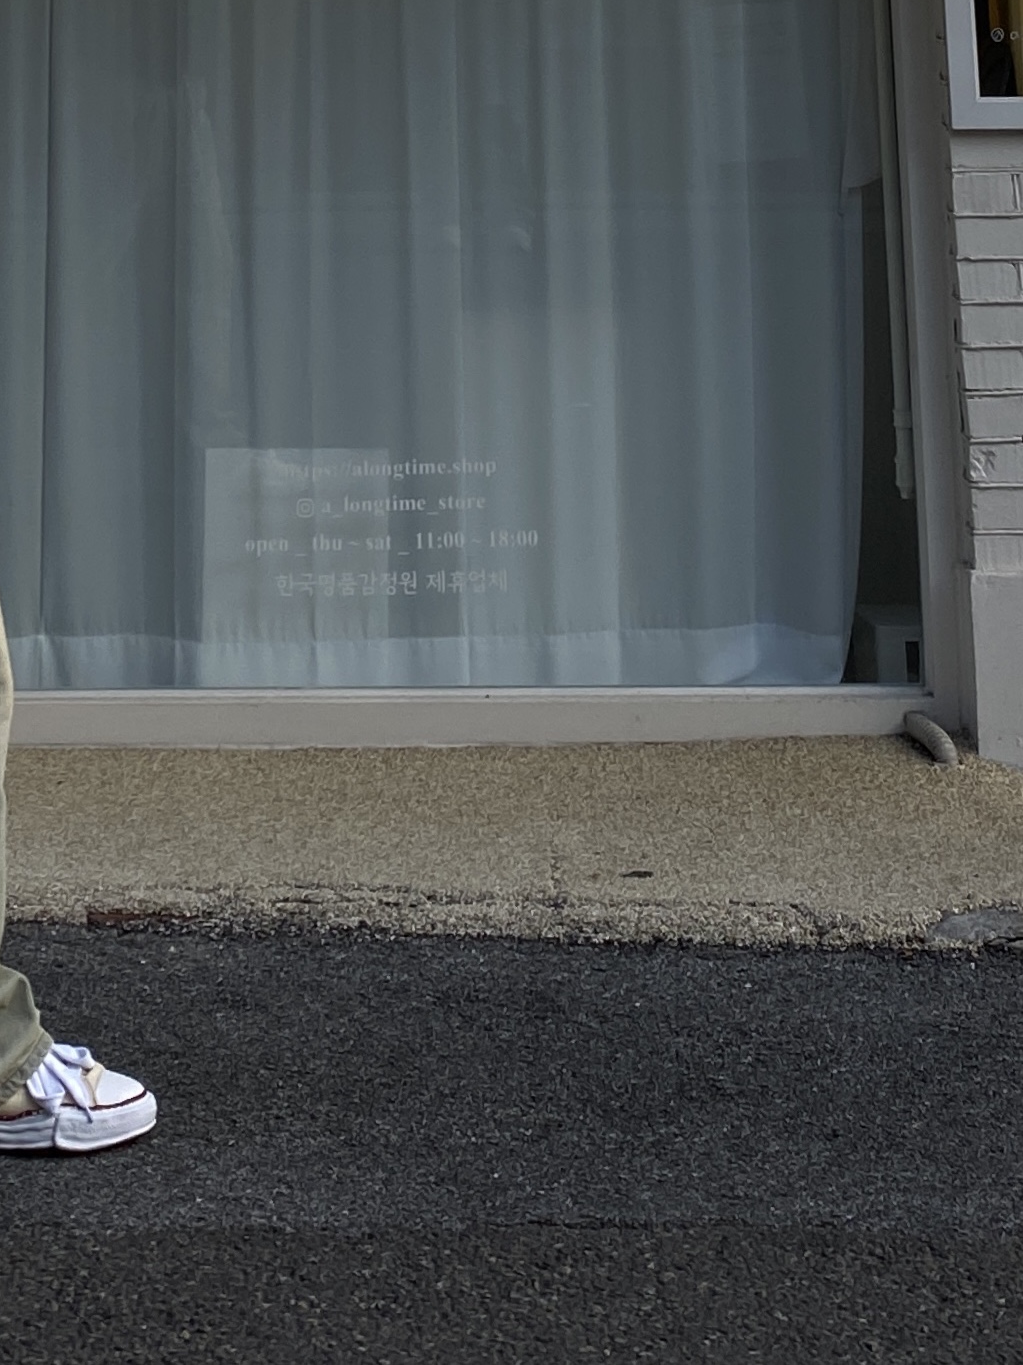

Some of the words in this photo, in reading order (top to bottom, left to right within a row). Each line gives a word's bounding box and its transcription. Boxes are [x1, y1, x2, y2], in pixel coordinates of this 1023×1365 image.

[244, 535, 289, 557] open
[364, 533, 392, 551] sat
[415, 531, 466, 550] 11:00
[488, 528, 539, 548] 18:00
[275, 569, 419, 597] 한국명품감정원
[426, 568, 509, 594] 제휴업체
